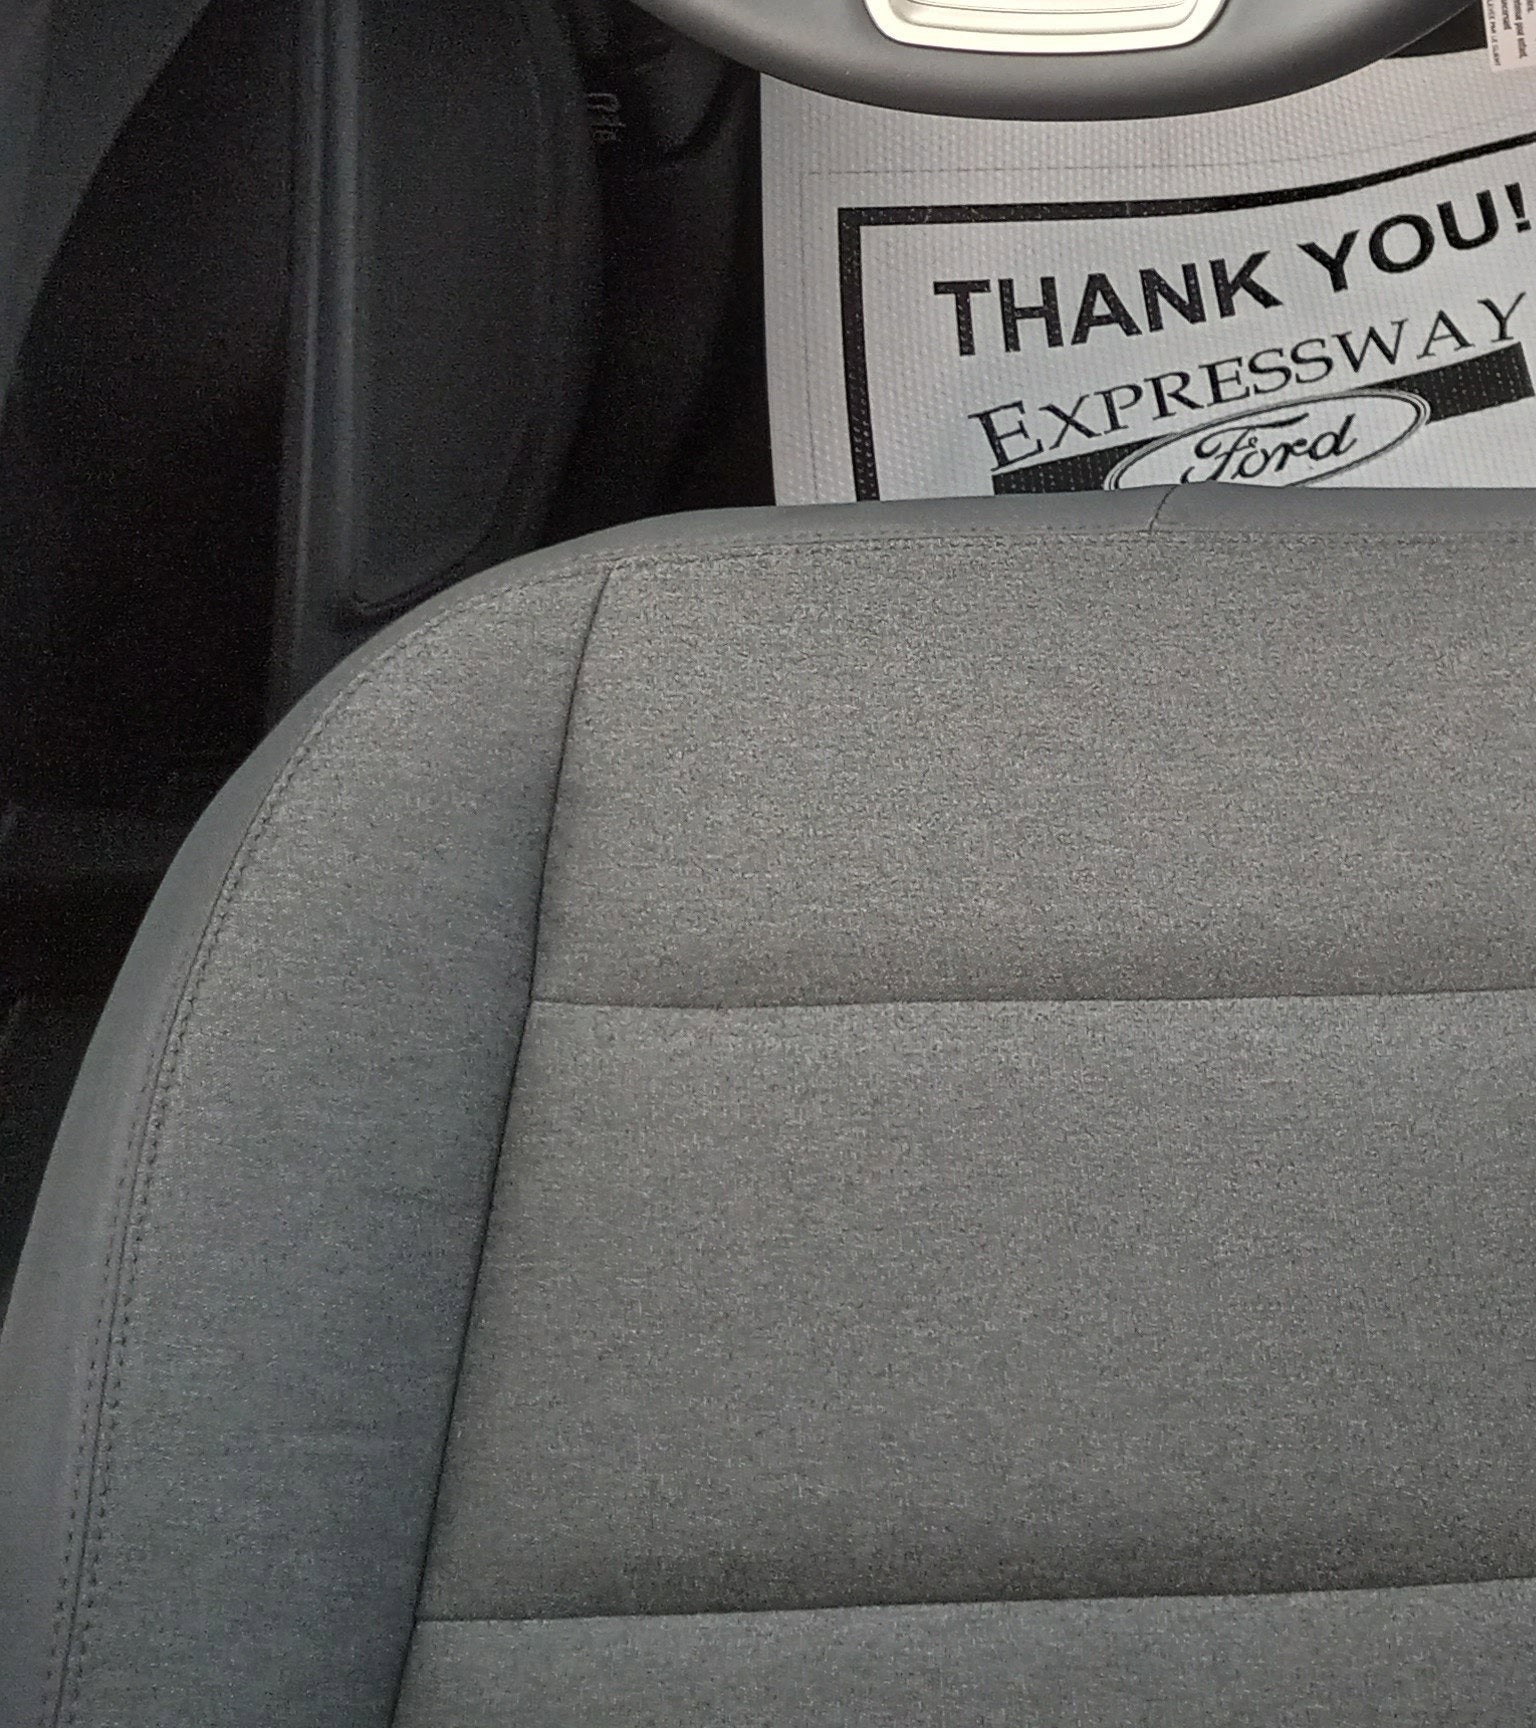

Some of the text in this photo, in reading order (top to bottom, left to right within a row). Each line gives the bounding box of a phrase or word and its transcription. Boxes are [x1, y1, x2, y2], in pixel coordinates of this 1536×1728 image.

[932, 182, 1533, 358] THANK YOU!
[967, 290, 1528, 473] EXPRESSWAY
[1180, 411, 1360, 484] Ford
